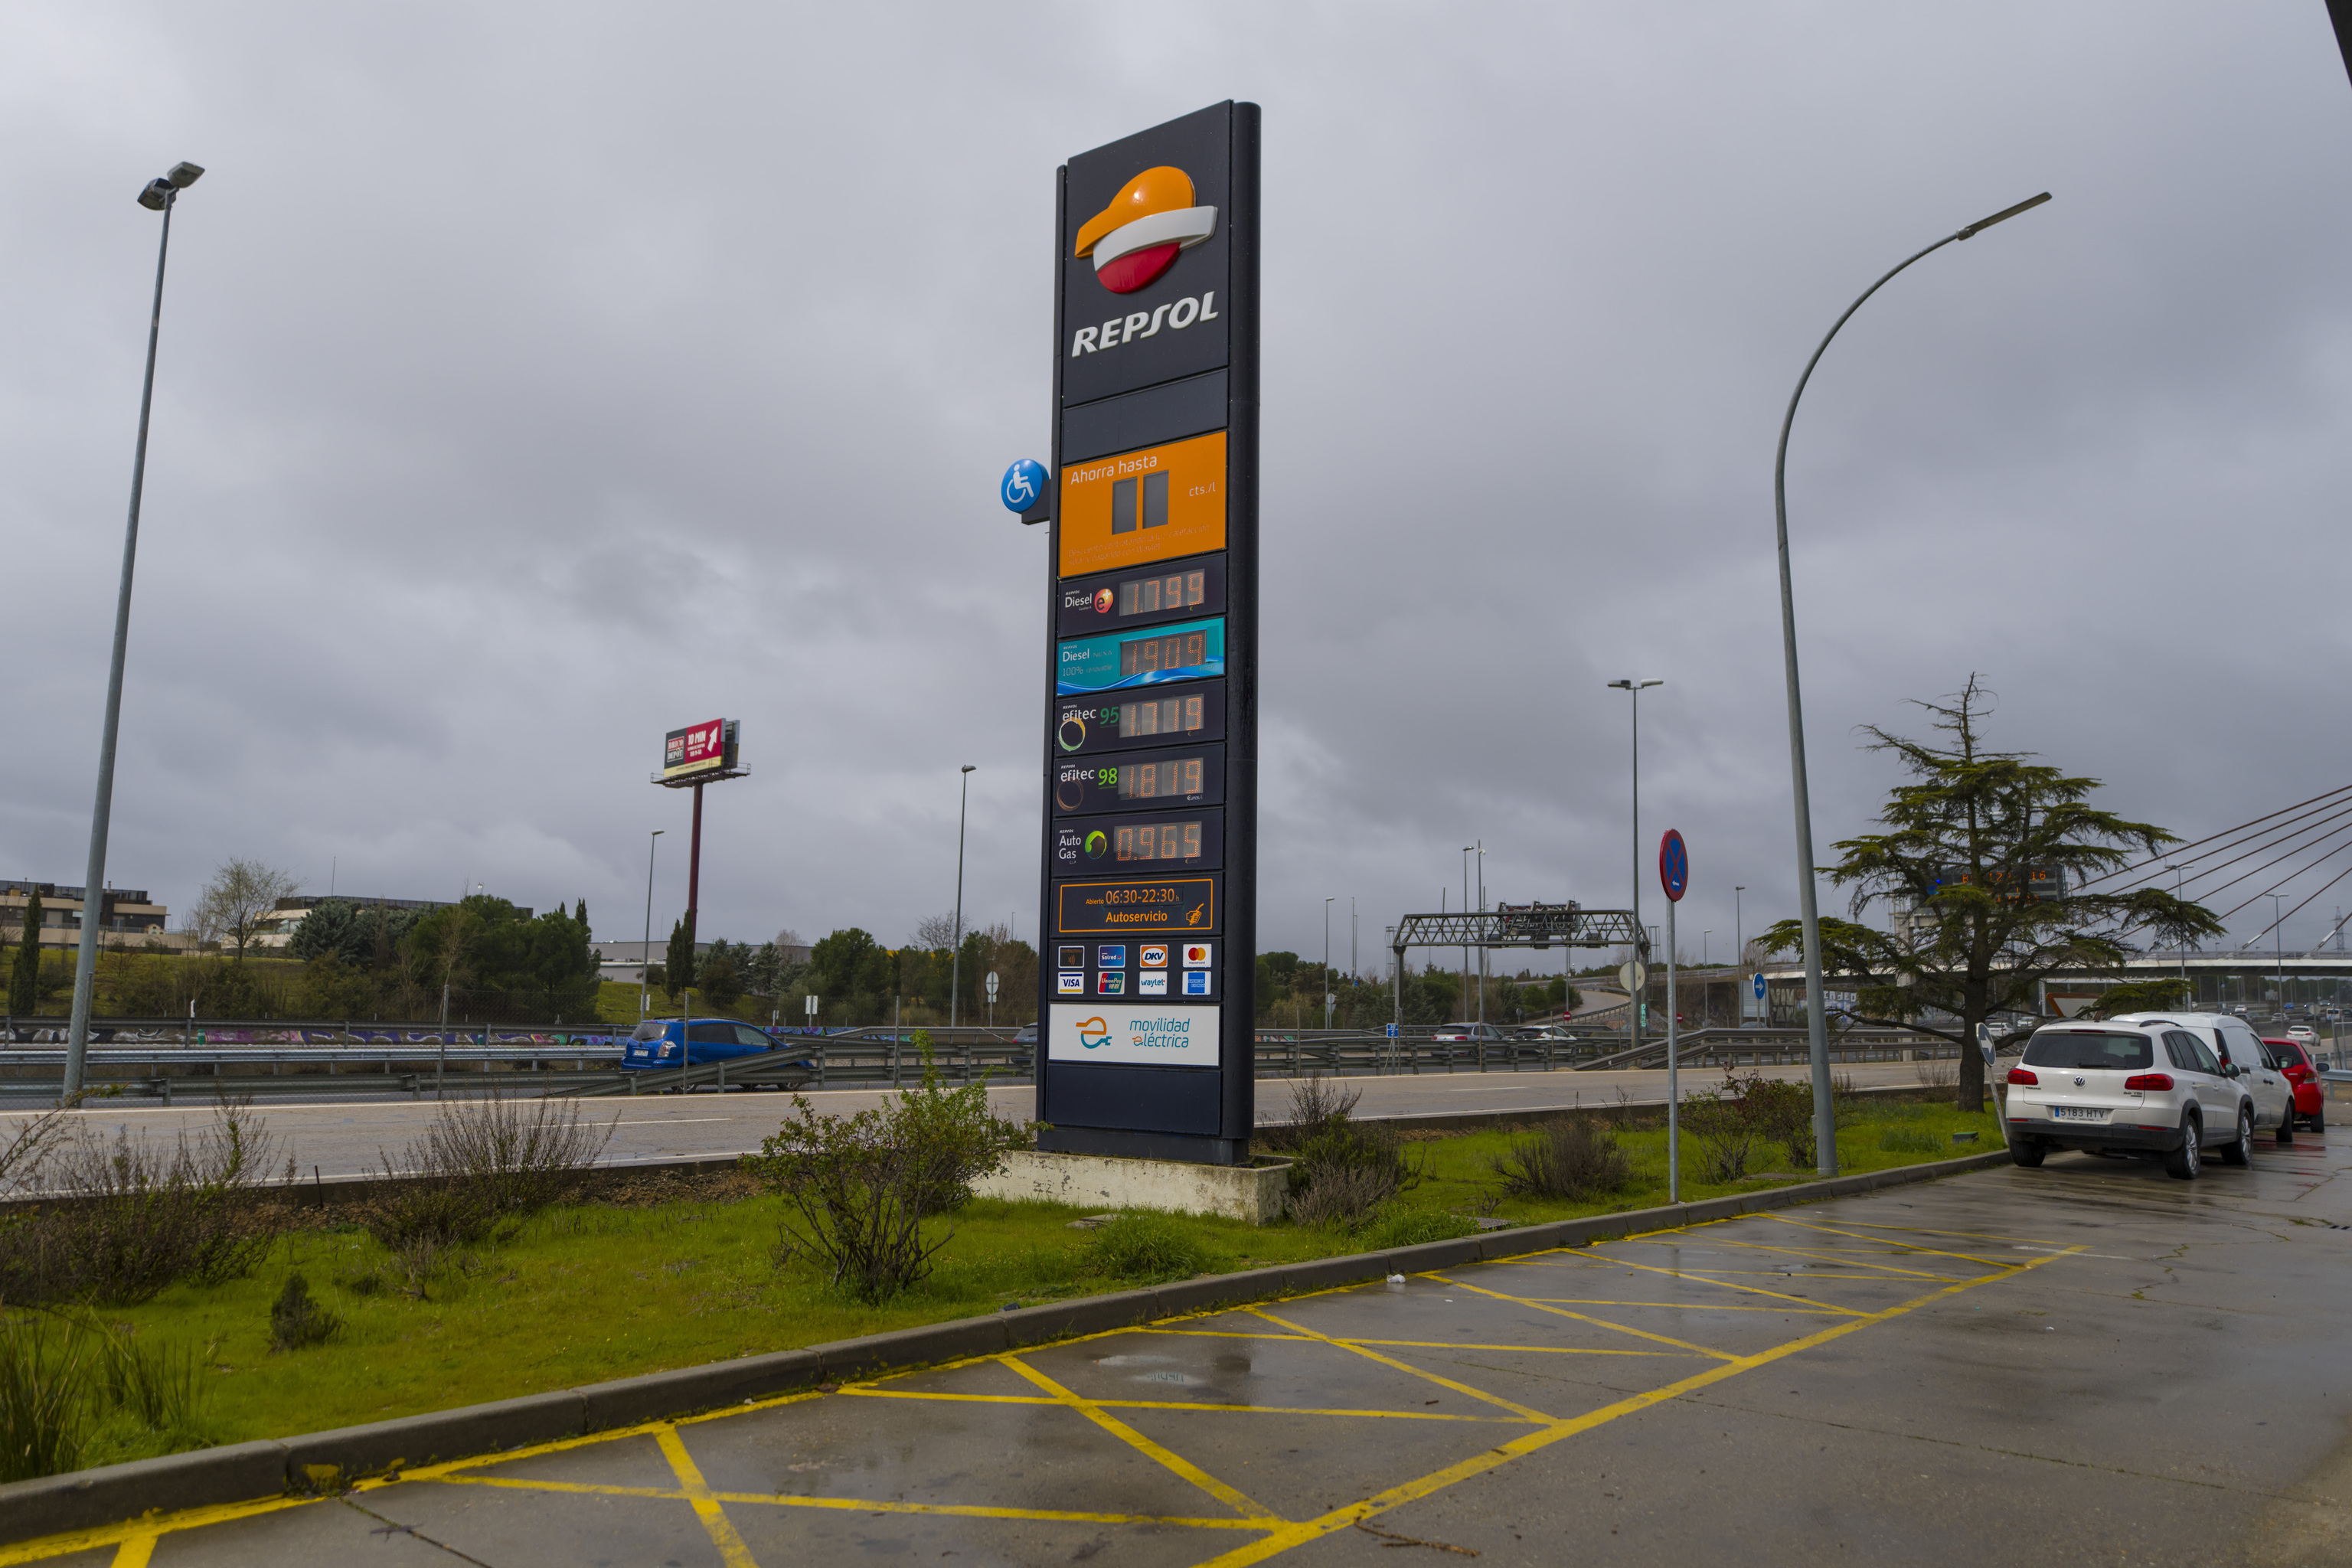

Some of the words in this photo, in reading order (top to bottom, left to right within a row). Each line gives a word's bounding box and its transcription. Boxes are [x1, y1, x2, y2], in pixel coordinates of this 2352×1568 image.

[1072, 291, 1219, 358] REPSOL
[1070, 464, 1114, 485] Ahorra
[1119, 456, 1158, 474] hasta
[1188, 482, 1216, 497] cts./l
[1065, 593, 1093, 608] Diesel
[1063, 648, 1089, 662] Diesel
[1063, 666, 1083, 677] 100%
[1062, 709, 1097, 722] efitec
[1099, 706, 1119, 725] 95
[688, 733, 694, 746] 10
[694, 730, 706, 743] MIN
[1060, 769, 1095, 782] efitec
[1098, 767, 1118, 786] 98
[1059, 835, 1082, 847] Auto
[1058, 848, 1076, 860] Gas
[1106, 888, 1175, 904] 06:30-22:30
[1106, 910, 1168, 923] Autoservicio
[1144, 952, 1164, 960] DKV
[1063, 978, 1080, 987] VISA
[1141, 978, 1165, 988] waylet
[1129, 1018, 1191, 1032] movilidad
[1132, 1032, 1189, 1048] eléctrica
[2060, 1108, 2083, 1118] 5183
[2086, 1109, 2104, 1119] HTV
